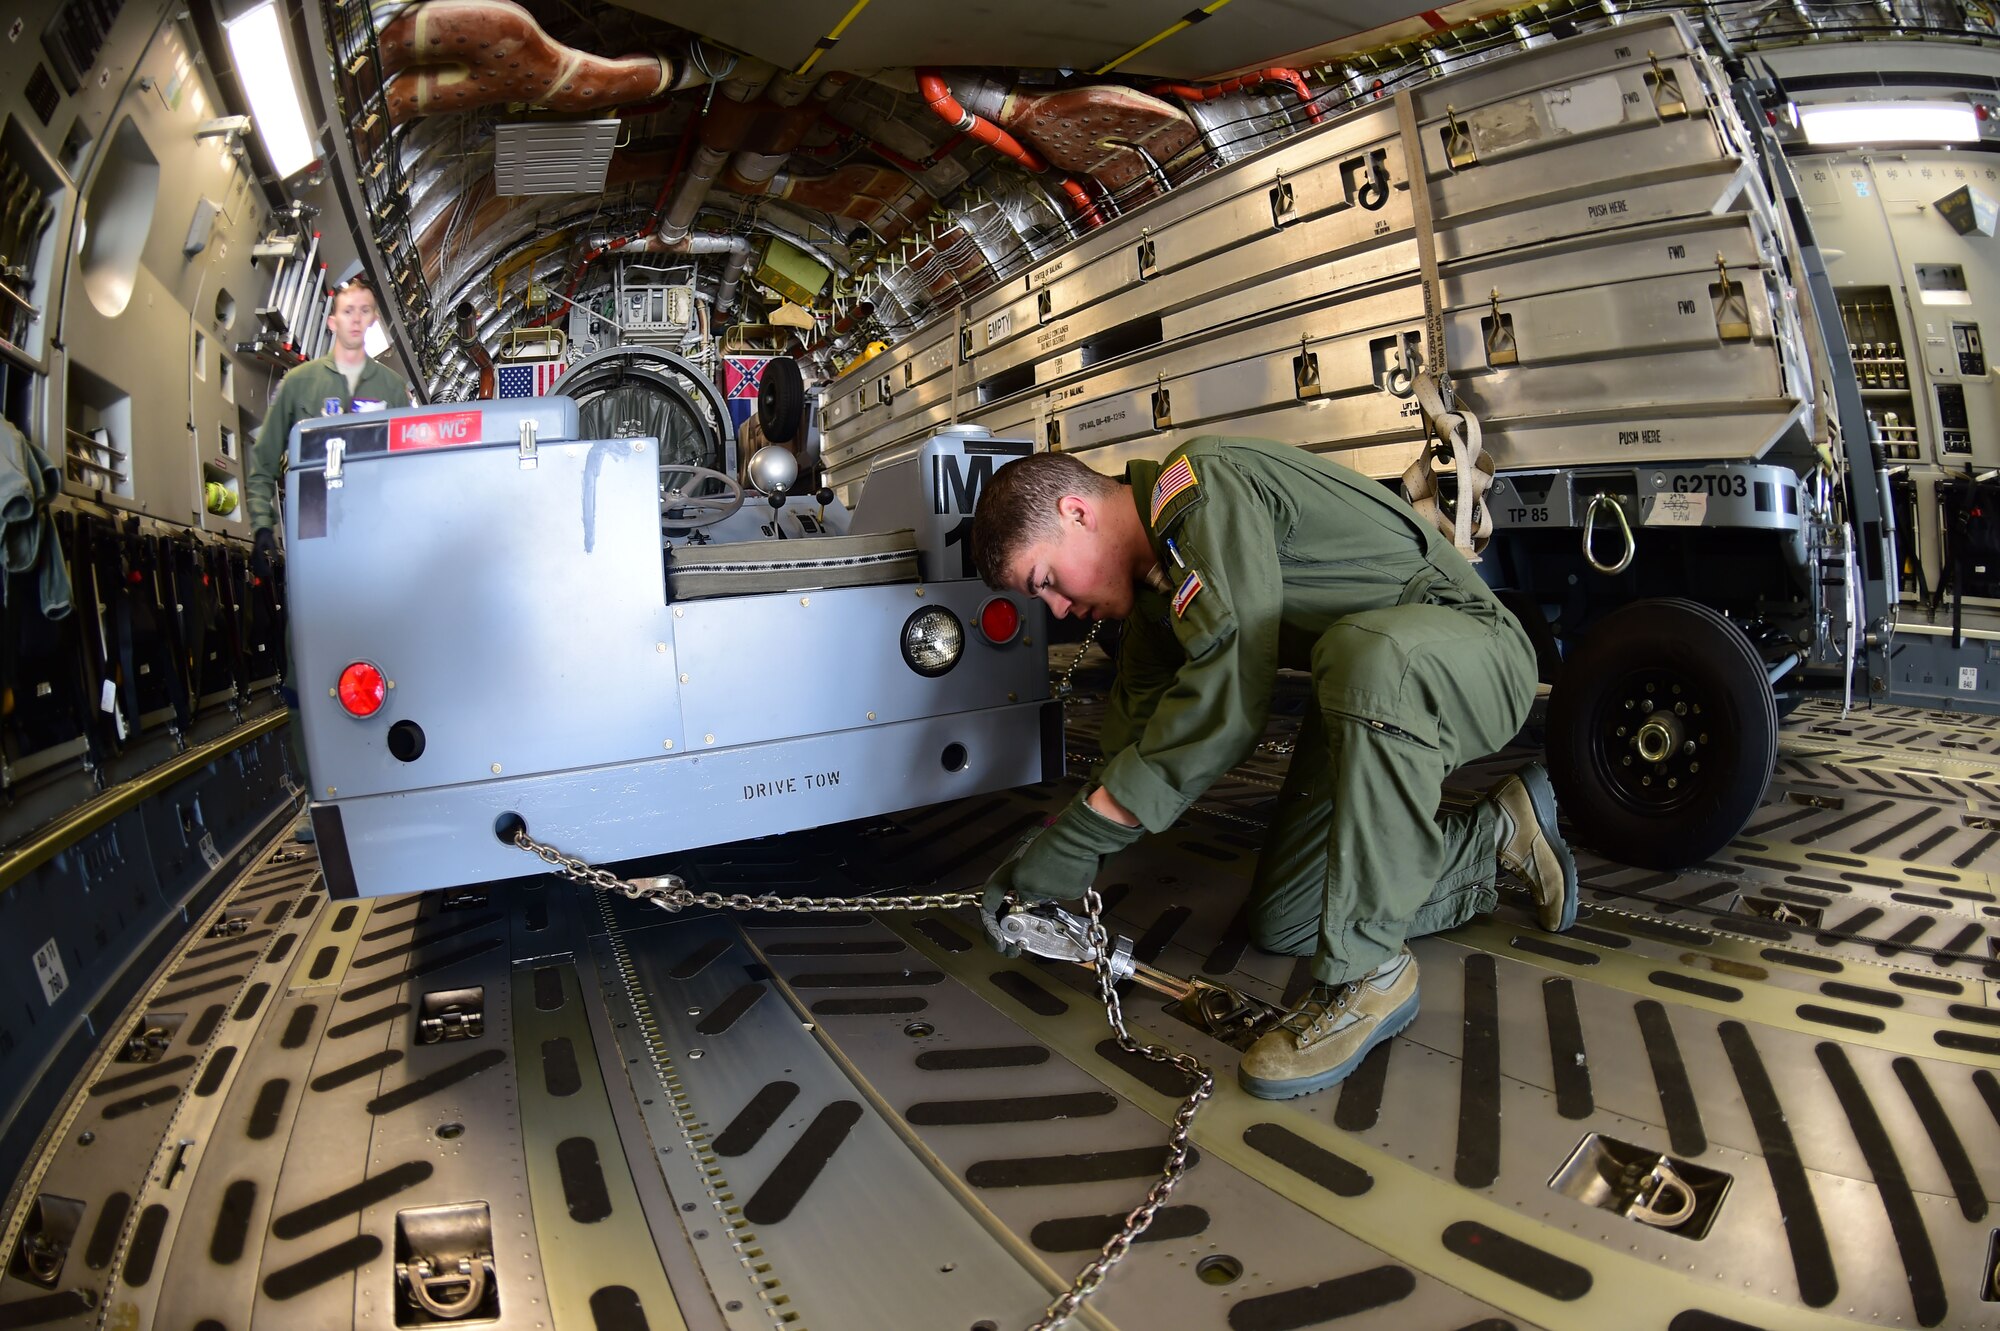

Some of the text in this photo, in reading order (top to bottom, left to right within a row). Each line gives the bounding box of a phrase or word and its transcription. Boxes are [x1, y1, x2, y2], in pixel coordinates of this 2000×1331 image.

[1614, 46, 1632, 59] FWD
[1622, 92, 1640, 104] FWD
[1588, 200, 1628, 218] PUSH HERE
[1668, 245, 1686, 260] FWD
[1050, 261, 1063, 274] BALANCE
[1678, 300, 1696, 314] FWD
[988, 313, 1010, 340] EMPTY
[1070, 385, 1084, 396] BALANCE
[438, 420, 467, 440] WG
[1619, 430, 1661, 445] PUSH HERE
[1673, 474, 1747, 497] G2T03
[1508, 508, 1548, 523] TP 85
[744, 770, 840, 800] DRIVE TOW
